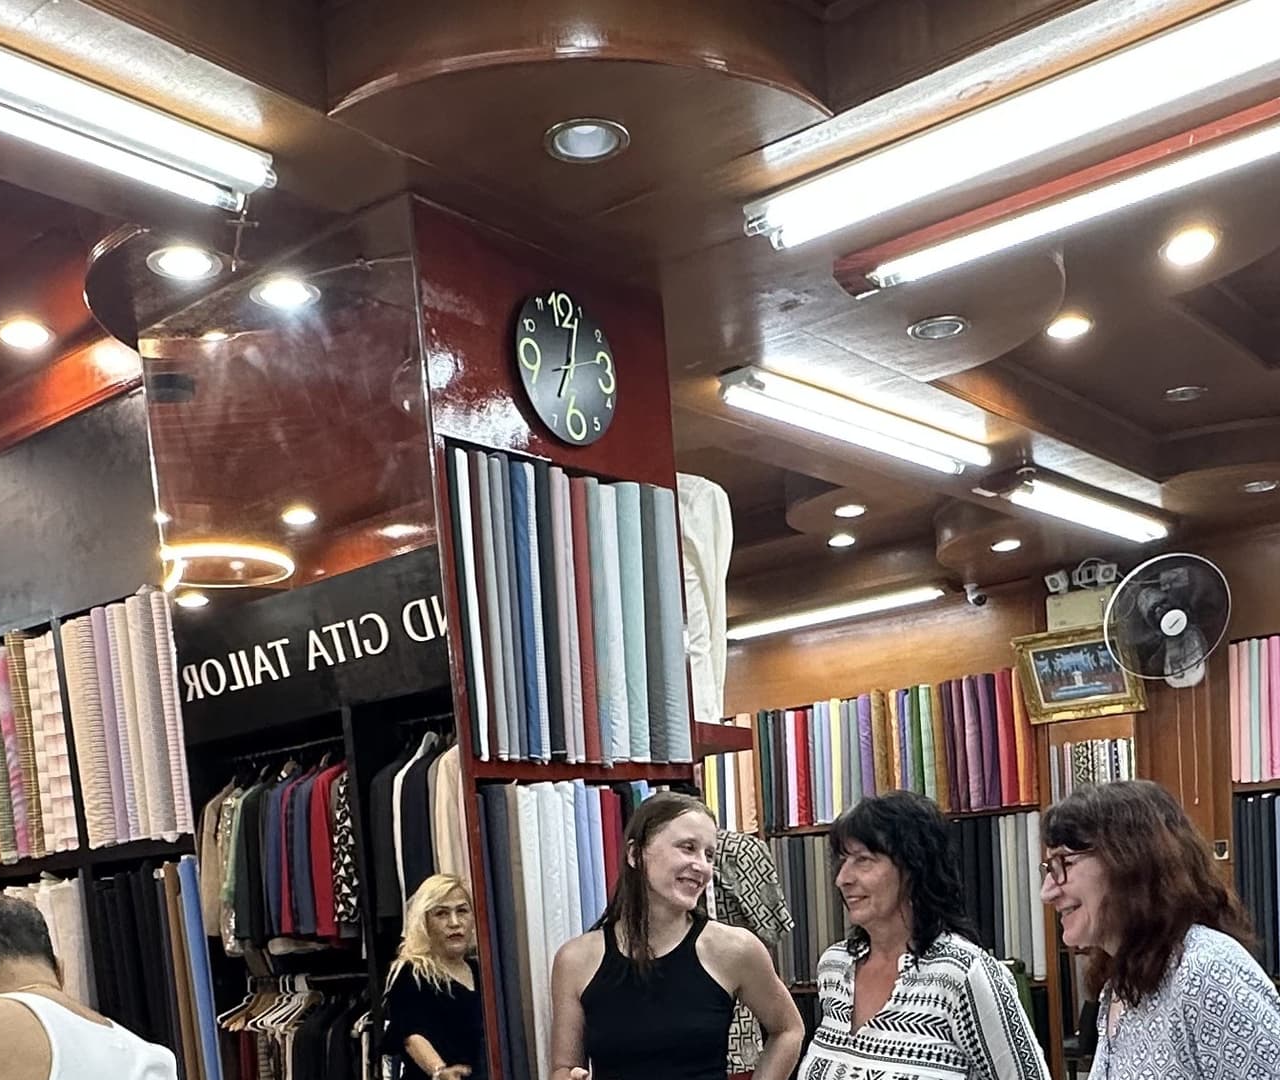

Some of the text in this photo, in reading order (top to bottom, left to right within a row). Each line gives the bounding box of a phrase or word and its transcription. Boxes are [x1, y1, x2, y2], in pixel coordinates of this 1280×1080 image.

[535, 297, 544, 311] 11
[548, 291, 576, 329] 12
[577, 306, 584, 319] 1
[523, 318, 536, 333] 10
[594, 328, 603, 343] 2
[519, 337, 541, 384] 9
[596, 351, 615, 395] 3
[605, 397, 613, 410] 4
[552, 413, 559, 428] 7
[566, 393, 587, 441] 6
[593, 417, 601, 432] 5
